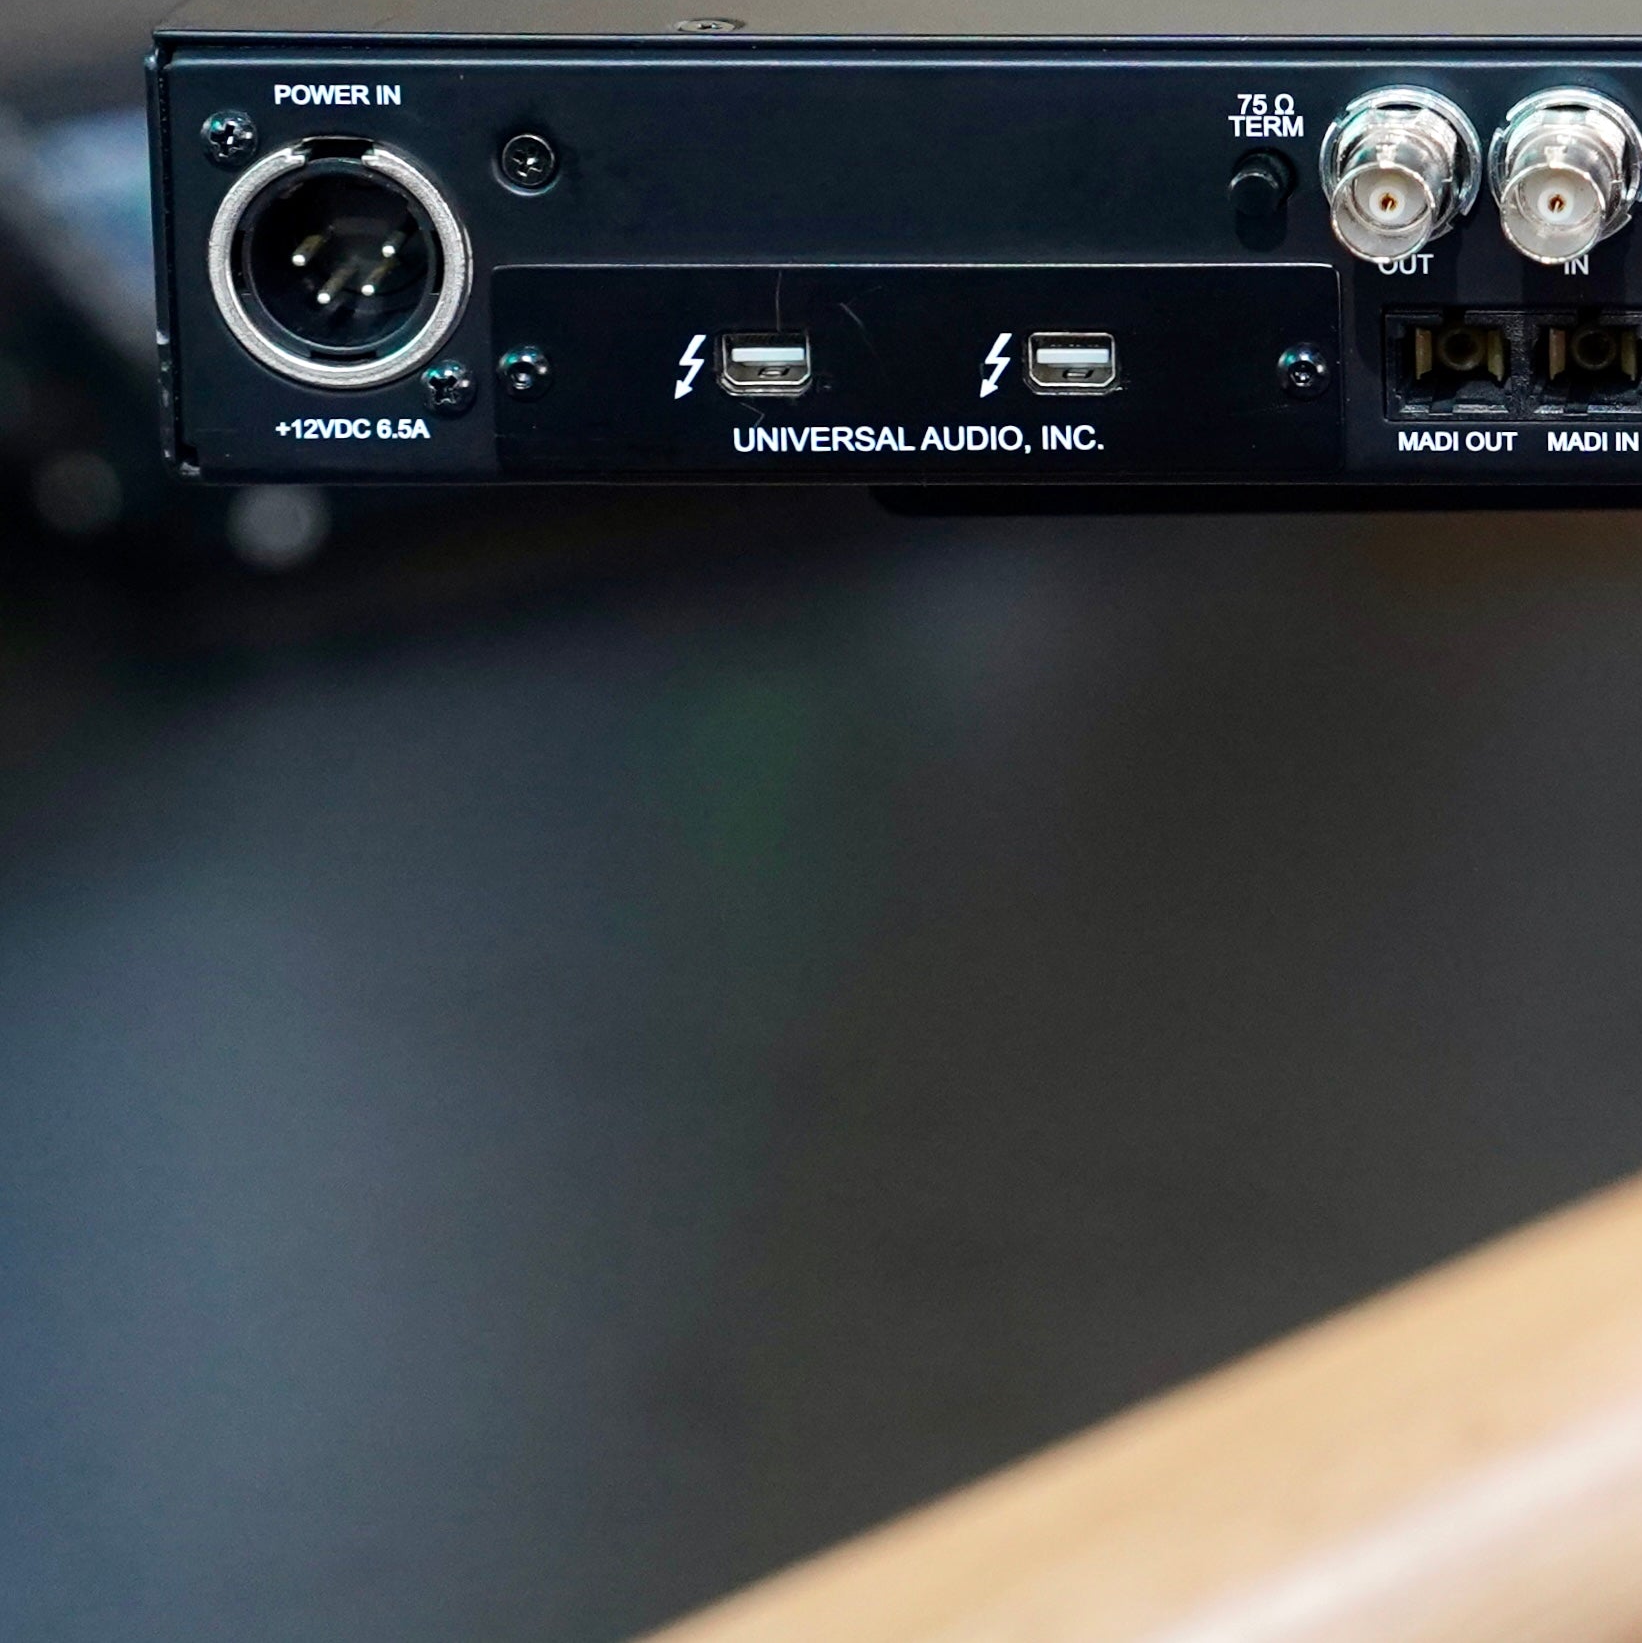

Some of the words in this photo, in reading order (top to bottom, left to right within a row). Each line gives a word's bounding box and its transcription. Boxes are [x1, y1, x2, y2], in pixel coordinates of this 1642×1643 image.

[273, 84, 371, 106] POWER
[375, 84, 402, 106] IN
[1236, 93, 1268, 116] 75
[1274, 93, 1295, 116] Ω
[1227, 115, 1305, 138] TERM
[1564, 254, 1590, 276] IN
[274, 417, 372, 440] +12VDC
[376, 418, 431, 440] 6.5A
[733, 425, 916, 453] UNIVERSAL
[920, 425, 1032, 455] AUDIO,
[1041, 424, 1105, 451] INC.
[1398, 430, 1459, 452] MADI
[1465, 430, 1519, 452] OUT
[1547, 431, 1609, 452] MADI
[1615, 431, 1640, 452] IN
